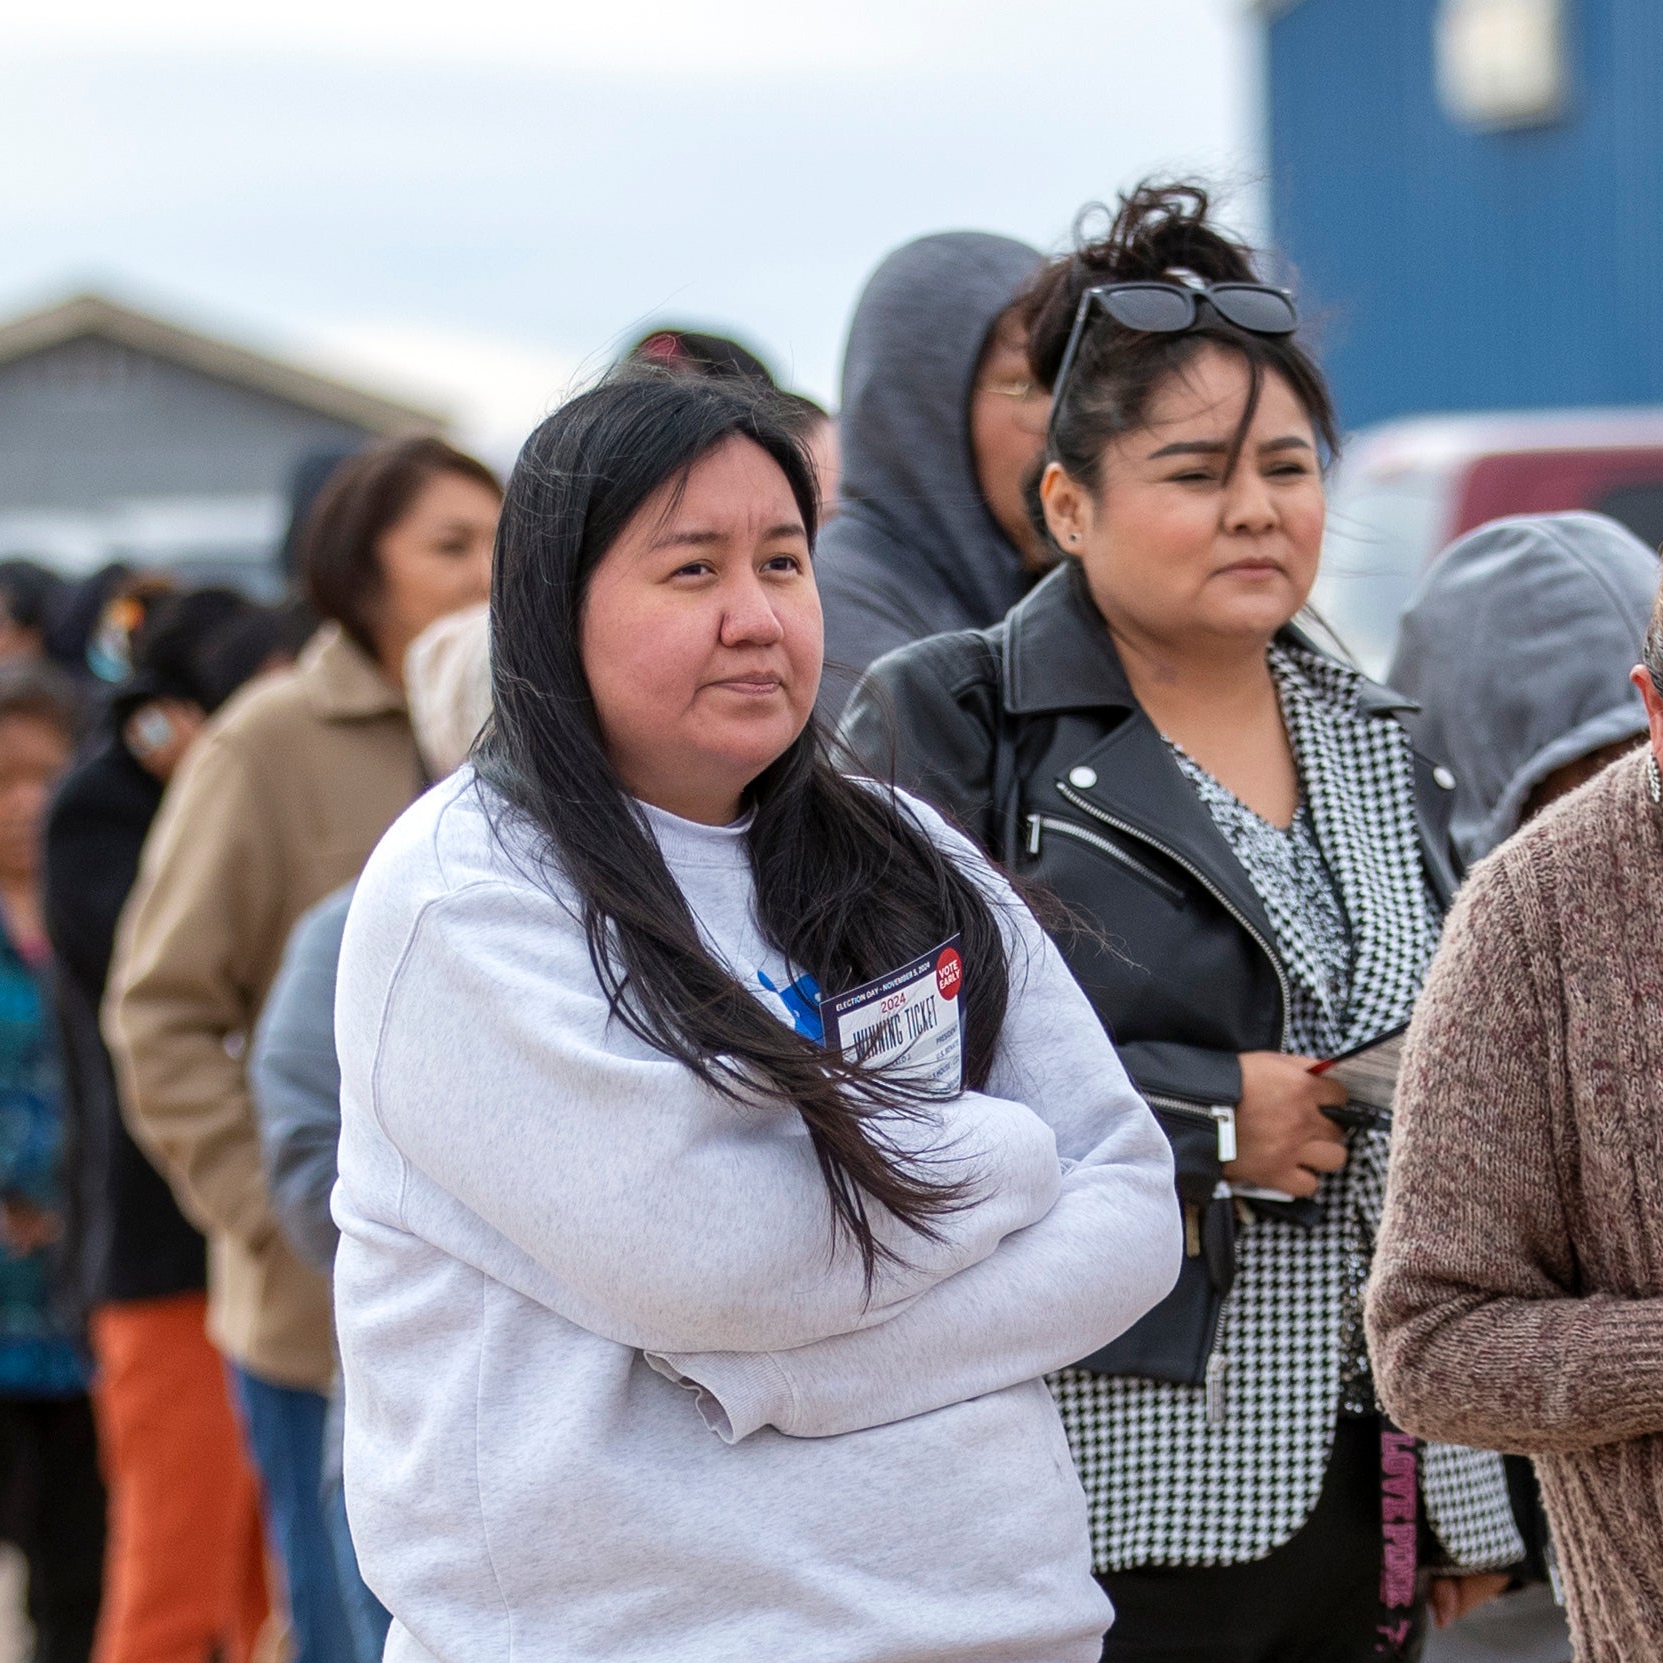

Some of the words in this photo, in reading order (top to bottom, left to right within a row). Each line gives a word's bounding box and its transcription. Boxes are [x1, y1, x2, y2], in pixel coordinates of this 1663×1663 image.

[836, 993, 866, 1012] ELECTION
[866, 987, 879, 998] DAY
[882, 971, 913, 991] NOVEMBER
[918, 961, 930, 974] 2024
[939, 960, 958, 979] VOTE
[939, 969, 960, 990] EARLY
[881, 992, 906, 1014] 2024
[853, 1012, 904, 1060] WINNING
[904, 995, 937, 1040] TICKET
[1381, 1432, 1417, 1523] LOVE
